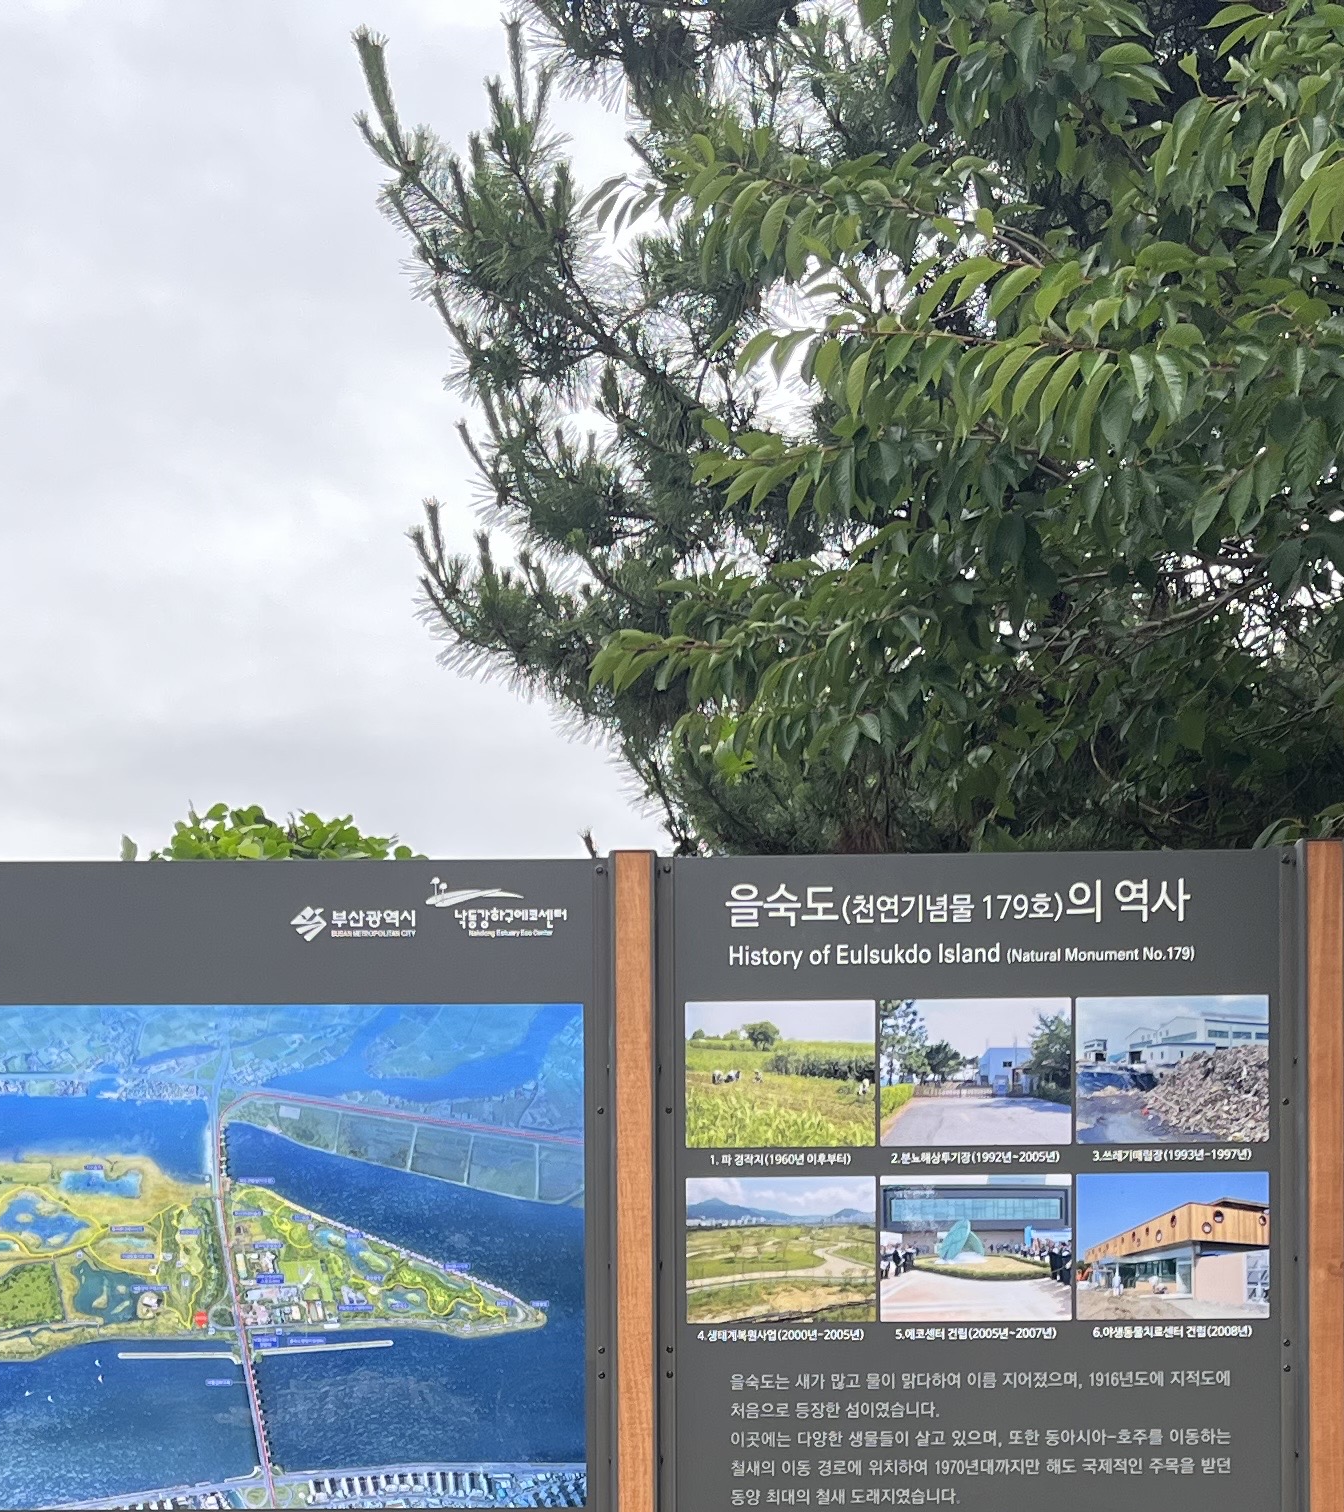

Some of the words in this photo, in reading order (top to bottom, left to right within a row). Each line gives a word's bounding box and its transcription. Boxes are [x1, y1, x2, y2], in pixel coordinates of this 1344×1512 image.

[724, 884, 974, 927] 을숙도(천연기념물
[982, 880, 1101, 922] 179호)의
[1114, 878, 1190, 921] 역사
[331, 909, 417, 928] 부산광역시
[454, 908, 567, 929] 낙동강하구에코센터
[729, 945, 803, 969] History
[809, 944, 831, 965] of
[836, 943, 931, 964] Eulsukdo
[938, 942, 1000, 963] Island
[1006, 948, 1061, 963] (Natural
[1064, 947, 1139, 961] Monument
[1142, 946, 1194, 960] No.179)
[710, 1154, 719, 1165] 1.
[729, 1373, 790, 1390] 을숙도는
[794, 1373, 825, 1389] 새가
[830, 1373, 860, 1390] 많고
[865, 1372, 895, 1389] 물이
[901, 1372, 960, 1389] 맑다하여
[967, 1371, 997, 1388] 이름
[1002, 1371, 1082, 1388] 지어졌으며,
[1088, 1371, 1164, 1387] 1916년도에
[1169, 1370, 1230, 1386] 지적도에
[730, 1402, 790, 1419] 처음으로
[794, 1401, 840, 1418] 등장한
[730, 1431, 791, 1447] 이곳에는
[797, 1430, 843, 1447] 다양한
[848, 1430, 908, 1447] 생물들이
[914, 1430, 946, 1446] 살고
[951, 1429, 1002, 1447] 있으며,
[1008, 1429, 1040, 1446] 또한
[1044, 1428, 1163, 1446] 동아시아-호주를
[1169, 1428, 1231, 1445] 이동하는
